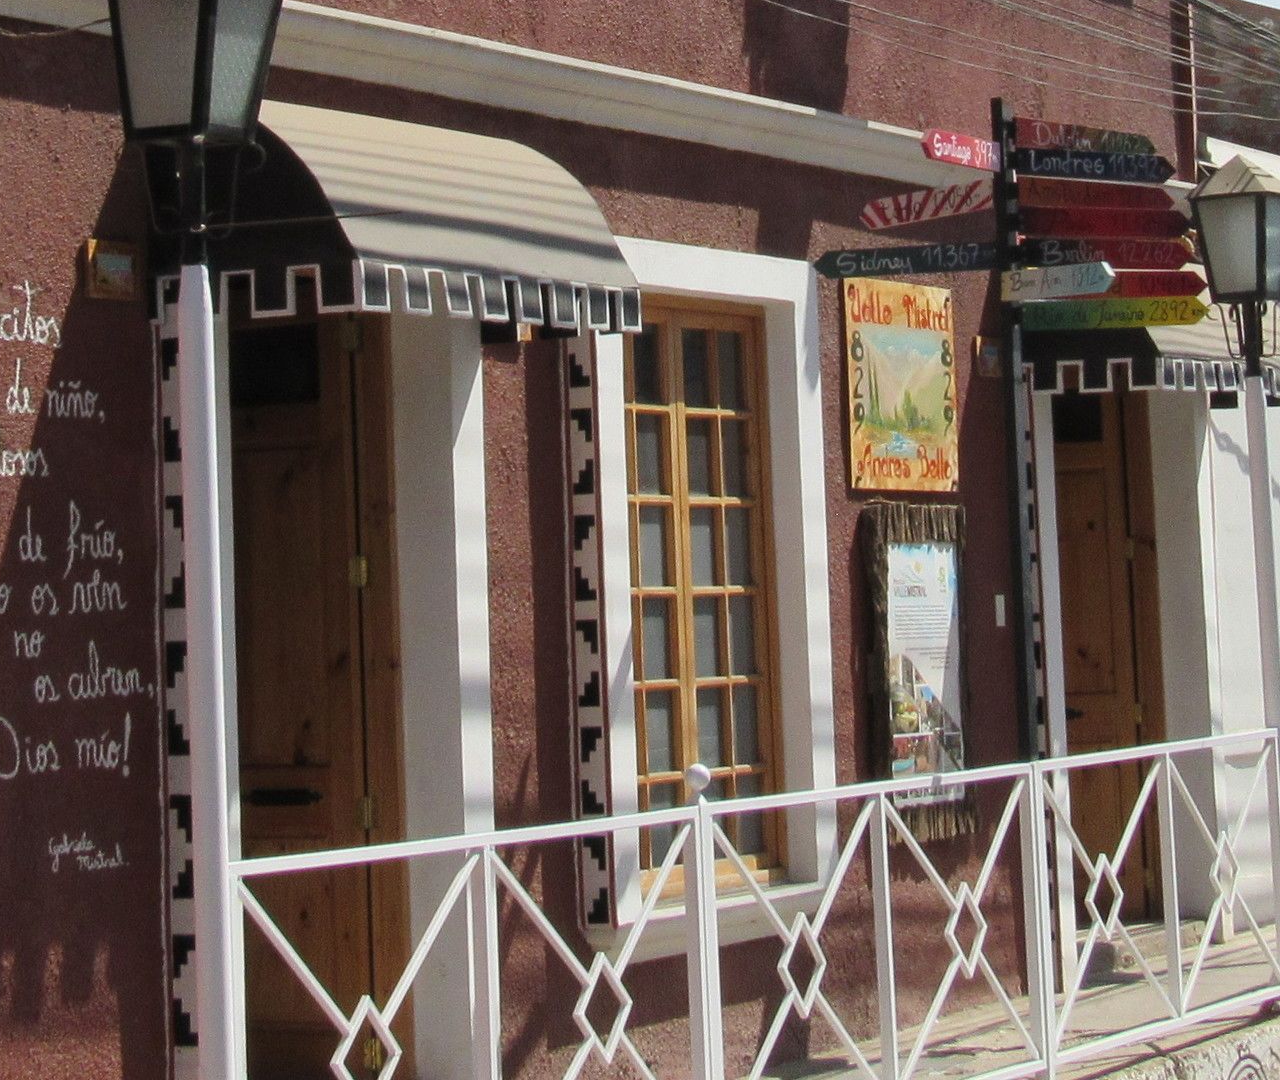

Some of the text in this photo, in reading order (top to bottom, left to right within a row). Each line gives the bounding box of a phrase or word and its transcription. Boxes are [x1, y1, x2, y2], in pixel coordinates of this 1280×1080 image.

[1028, 149, 1105, 174] Londres
[836, 250, 913, 276] Sidney
[1149, 300, 1189, 322] 2892
[6, 358, 35, 414] de
[18, 506, 46, 561] de
[30, 582, 59, 616] os
[13, 629, 45, 659] no
[34, 673, 61, 703] os
